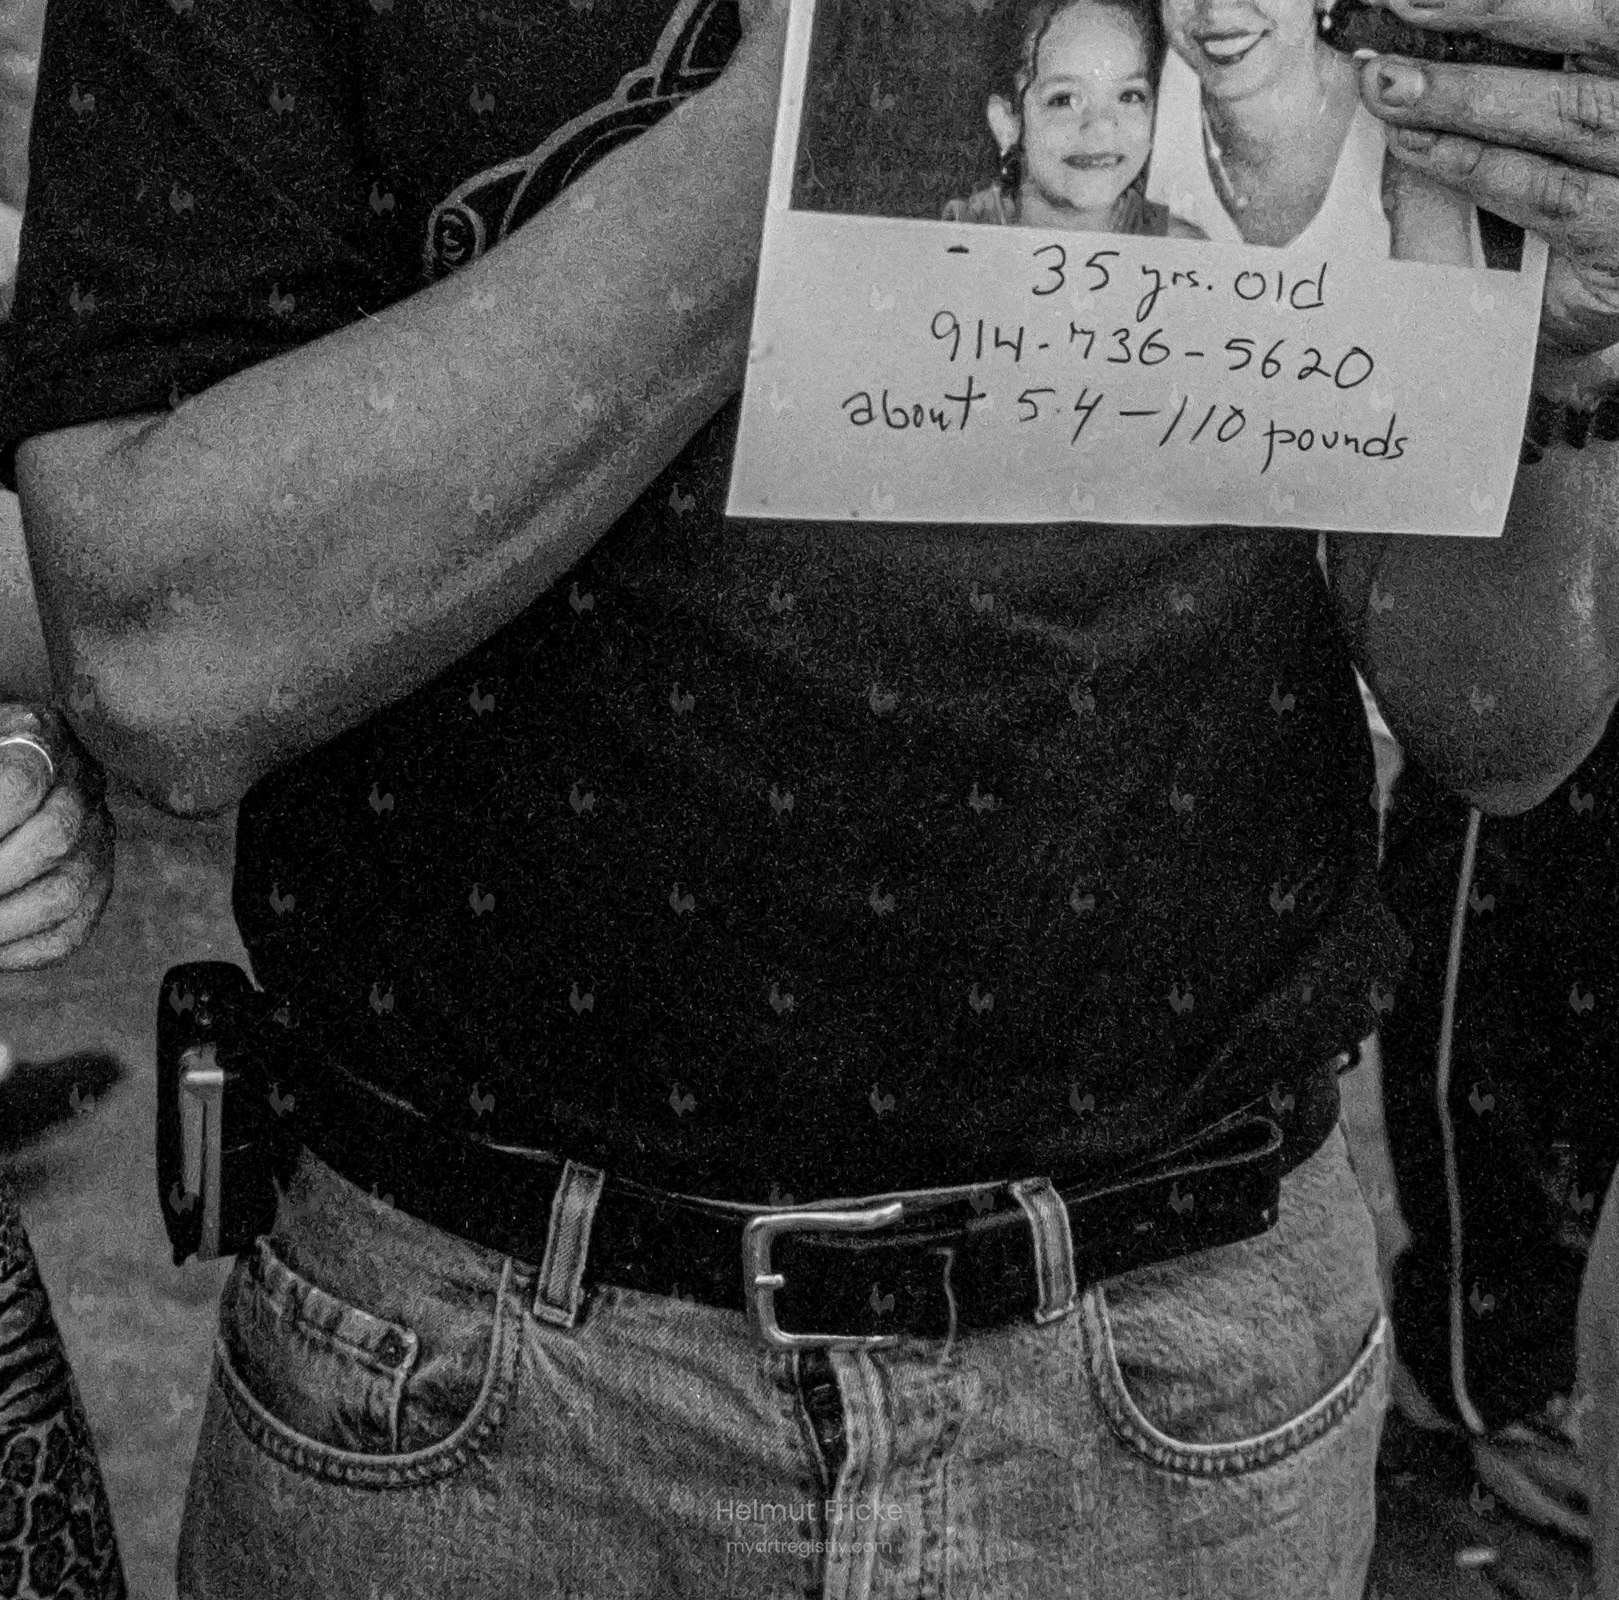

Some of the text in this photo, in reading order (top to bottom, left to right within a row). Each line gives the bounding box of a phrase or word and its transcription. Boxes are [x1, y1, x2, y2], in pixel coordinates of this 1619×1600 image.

[1030, 244, 1122, 298] 35
[1232, 261, 1328, 311] old
[930, 310, 1376, 390] 914-736-5620
[841, 375, 988, 432] about
[1260, 412, 1409, 475] pounds
